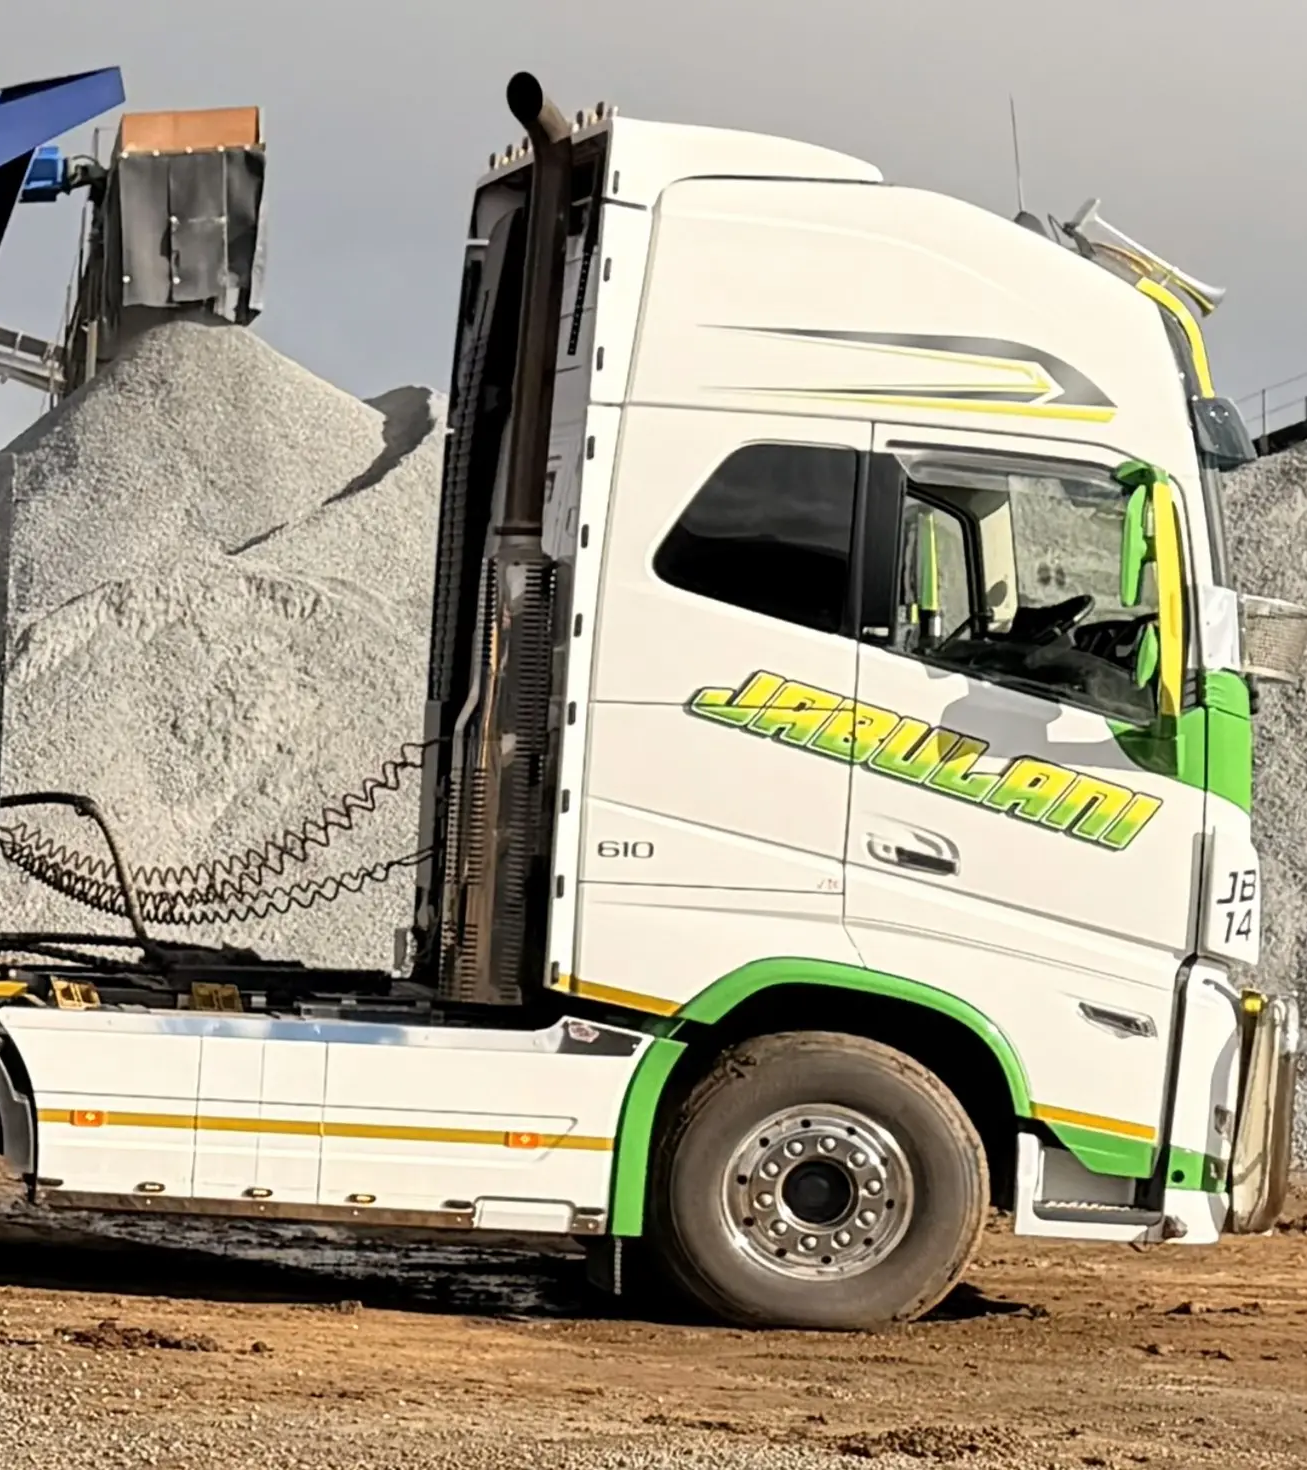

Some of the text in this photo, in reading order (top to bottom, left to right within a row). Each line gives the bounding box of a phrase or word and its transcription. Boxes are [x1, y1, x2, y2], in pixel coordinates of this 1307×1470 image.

[684, 669, 1164, 852] JABULANI
[597, 840, 655, 858] 610
[1216, 869, 1257, 904] JB
[1224, 908, 1252, 943] 14
